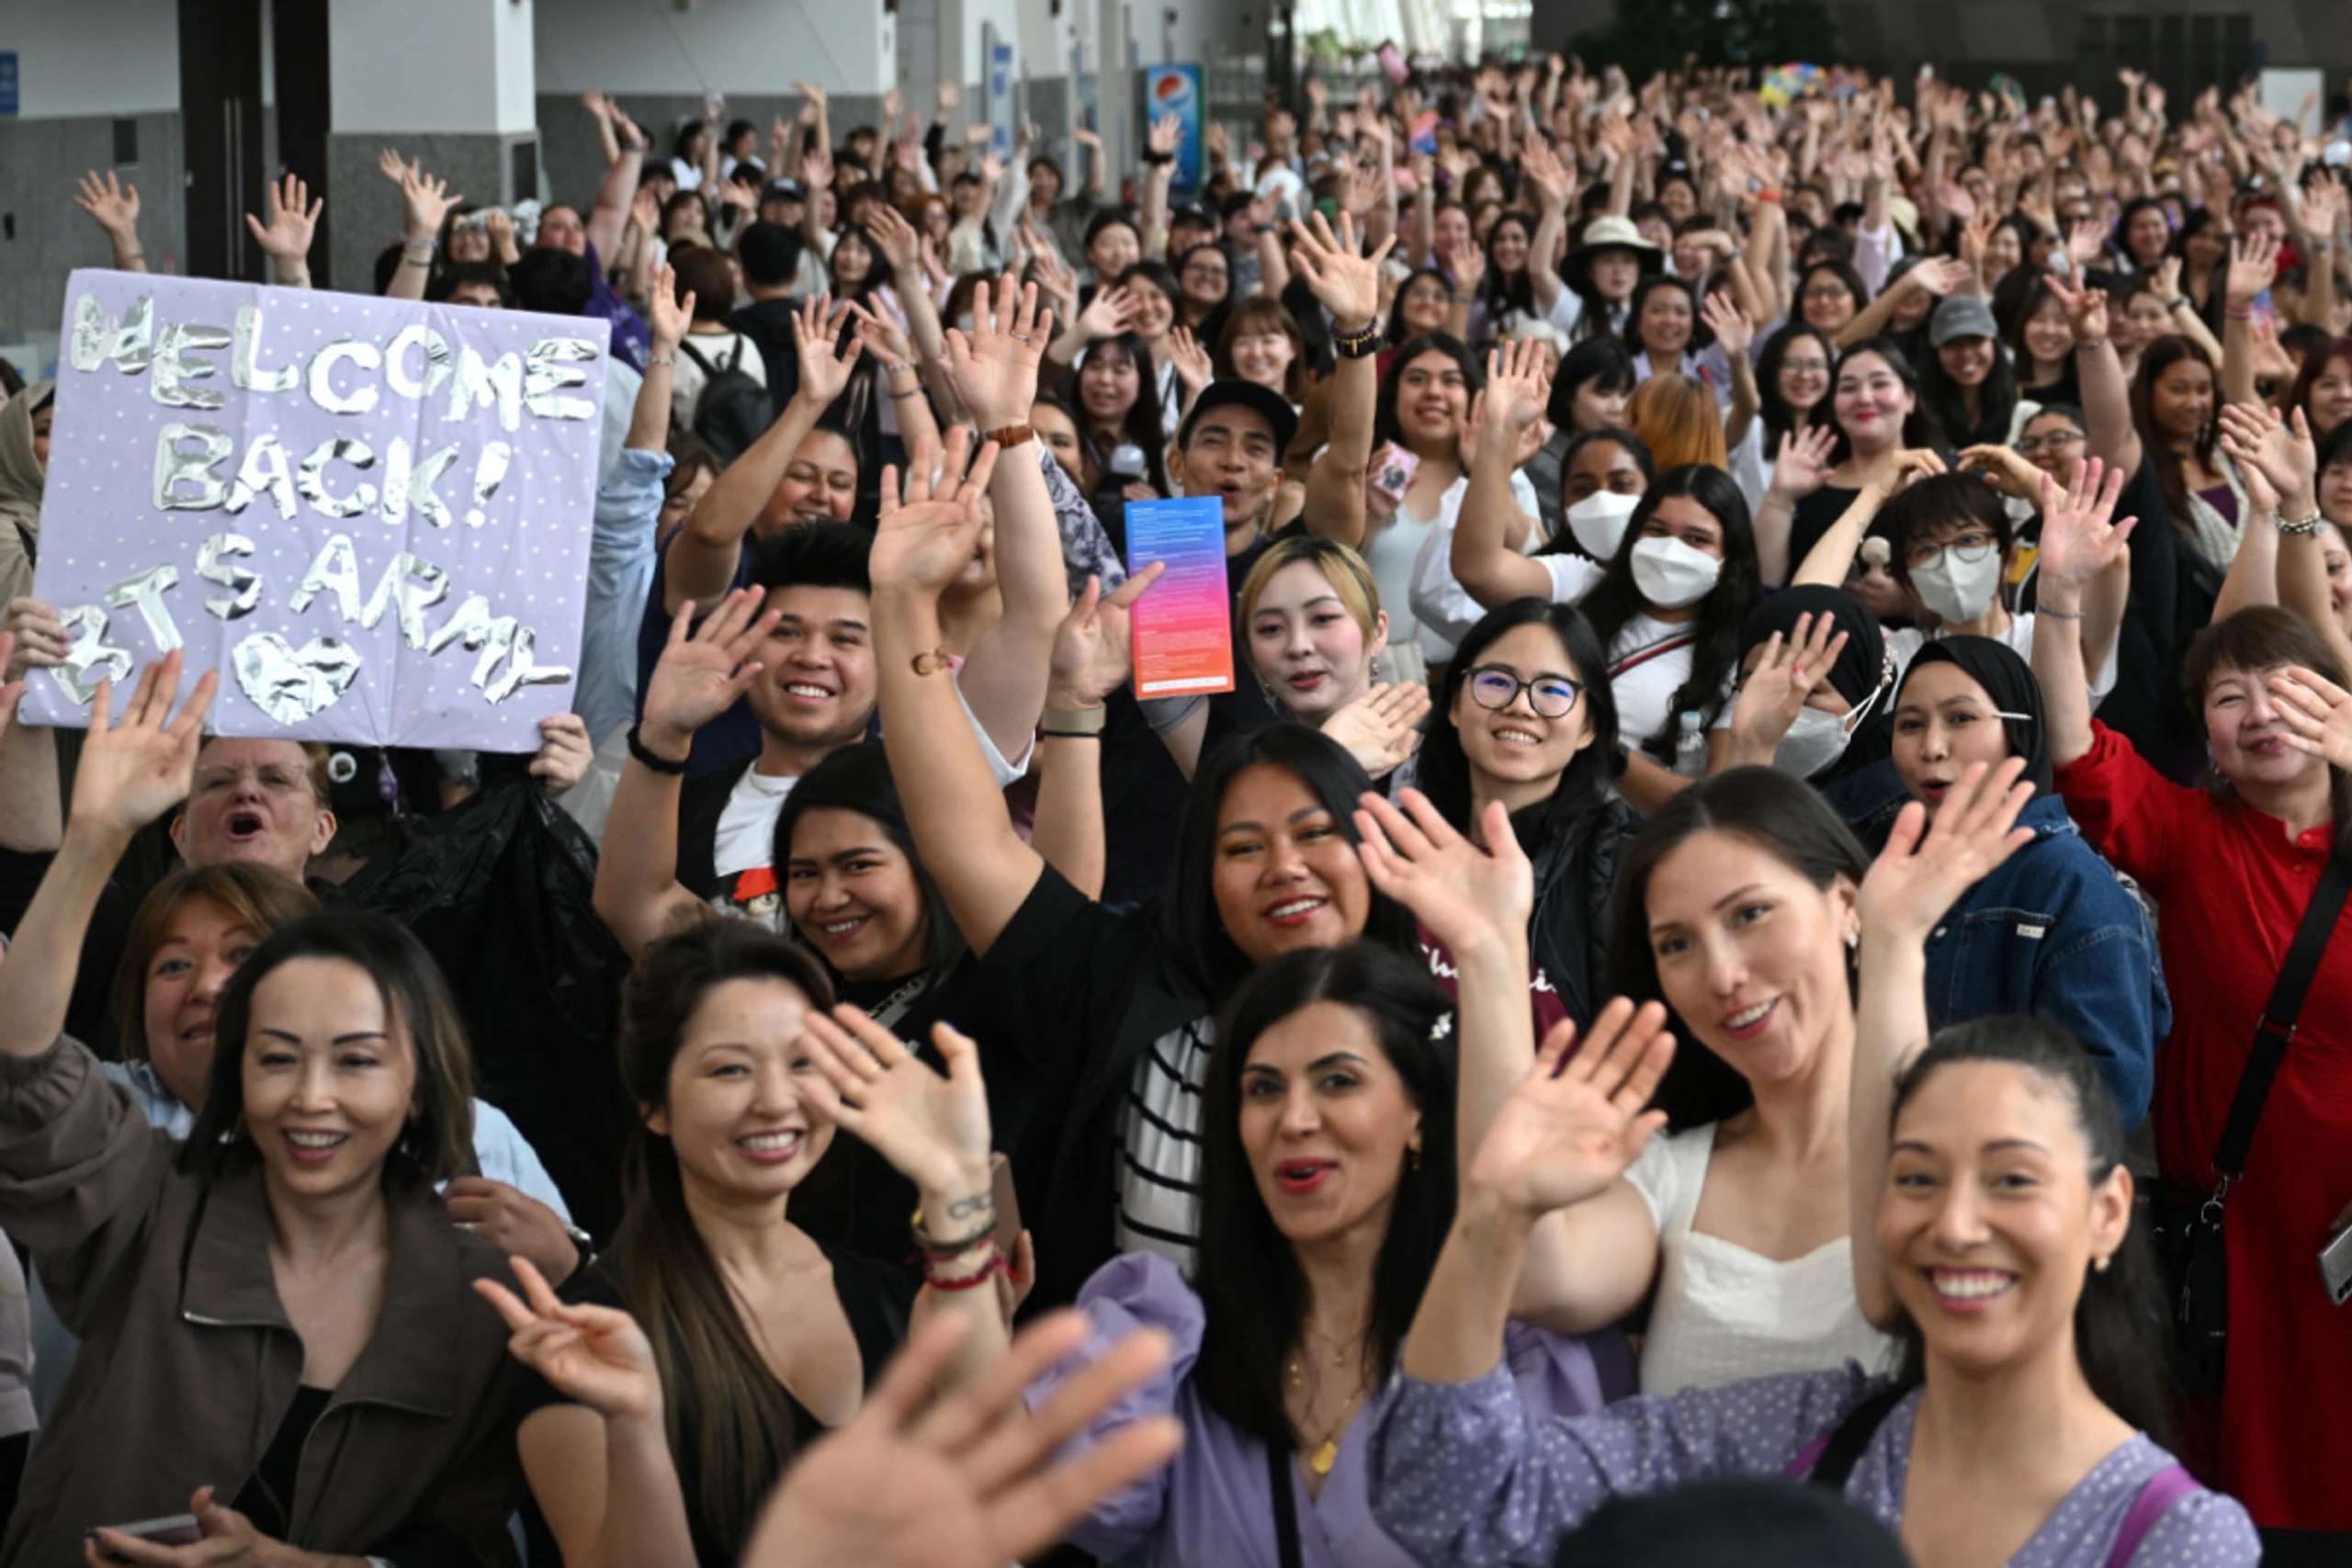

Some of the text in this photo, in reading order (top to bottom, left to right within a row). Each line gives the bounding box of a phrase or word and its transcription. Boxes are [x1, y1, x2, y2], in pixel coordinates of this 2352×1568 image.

[71, 293, 599, 432] WELCOME
[153, 422, 513, 528] BACK!
[51, 533, 572, 705] BTS ARMY
